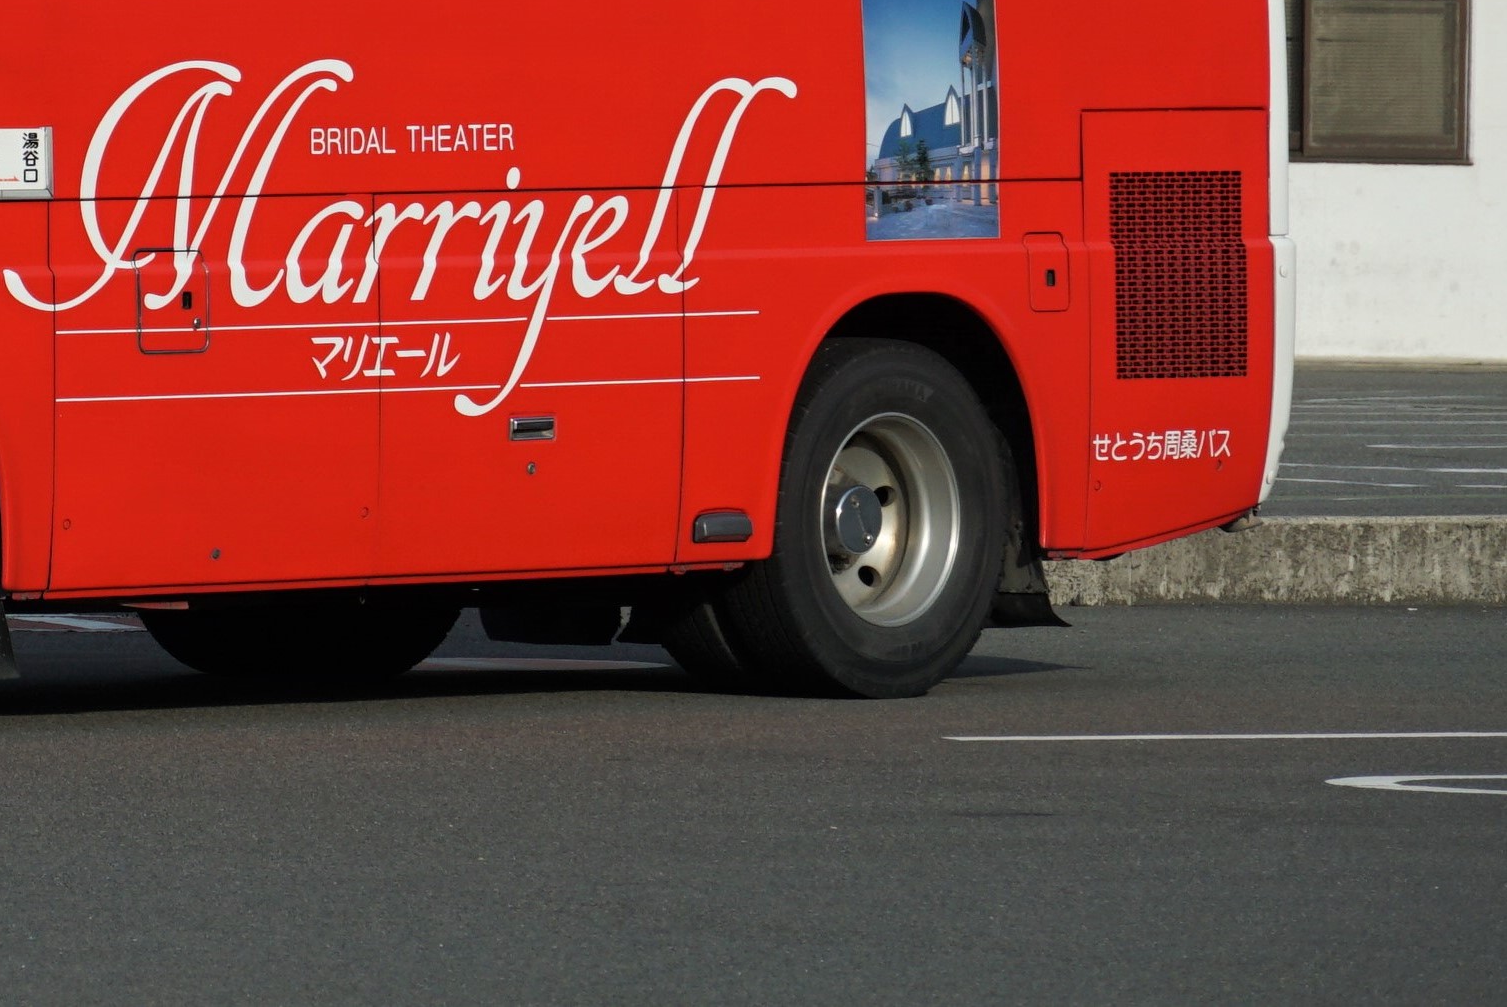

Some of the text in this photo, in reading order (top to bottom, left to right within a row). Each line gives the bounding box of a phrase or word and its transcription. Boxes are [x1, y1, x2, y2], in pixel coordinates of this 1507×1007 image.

[22, 132, 40, 183] 湯谷口
[309, 123, 515, 155] BRIDAL THEATER
[3, 59, 797, 417] Marriyell
[310, 331, 462, 382] マリエール
[1092, 429, 1231, 461] せとうち周桑バス
